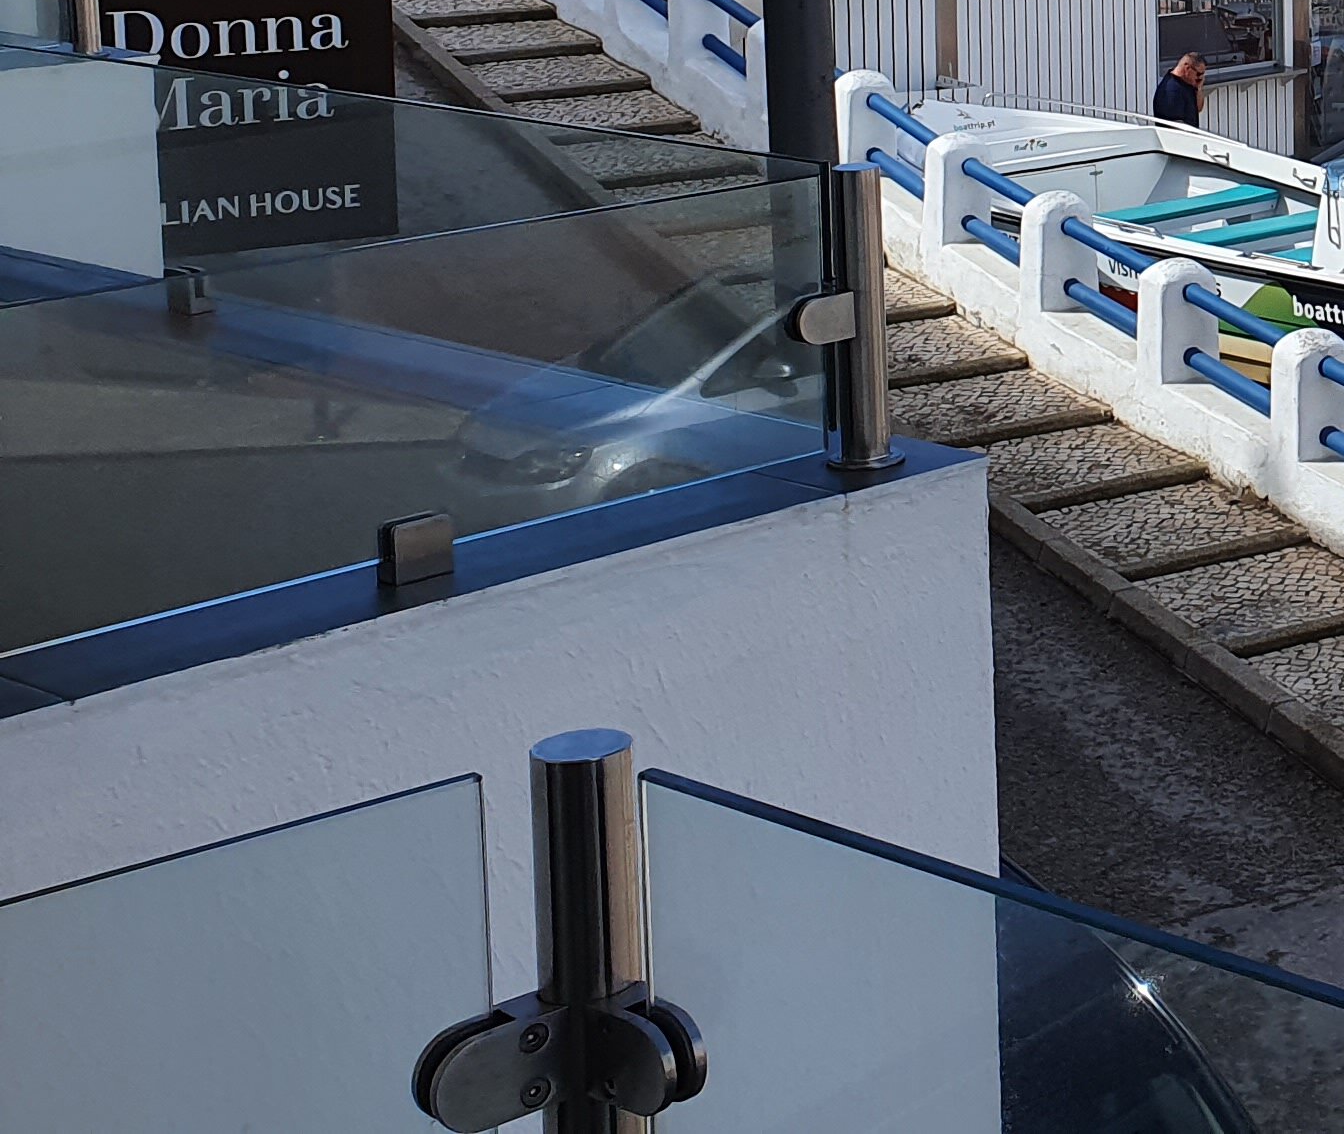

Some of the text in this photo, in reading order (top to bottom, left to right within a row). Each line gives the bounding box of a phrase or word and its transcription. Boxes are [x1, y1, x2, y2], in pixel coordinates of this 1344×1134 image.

[105, 10, 349, 59] Donna
[161, 183, 361, 226] LIAN HOUSE
